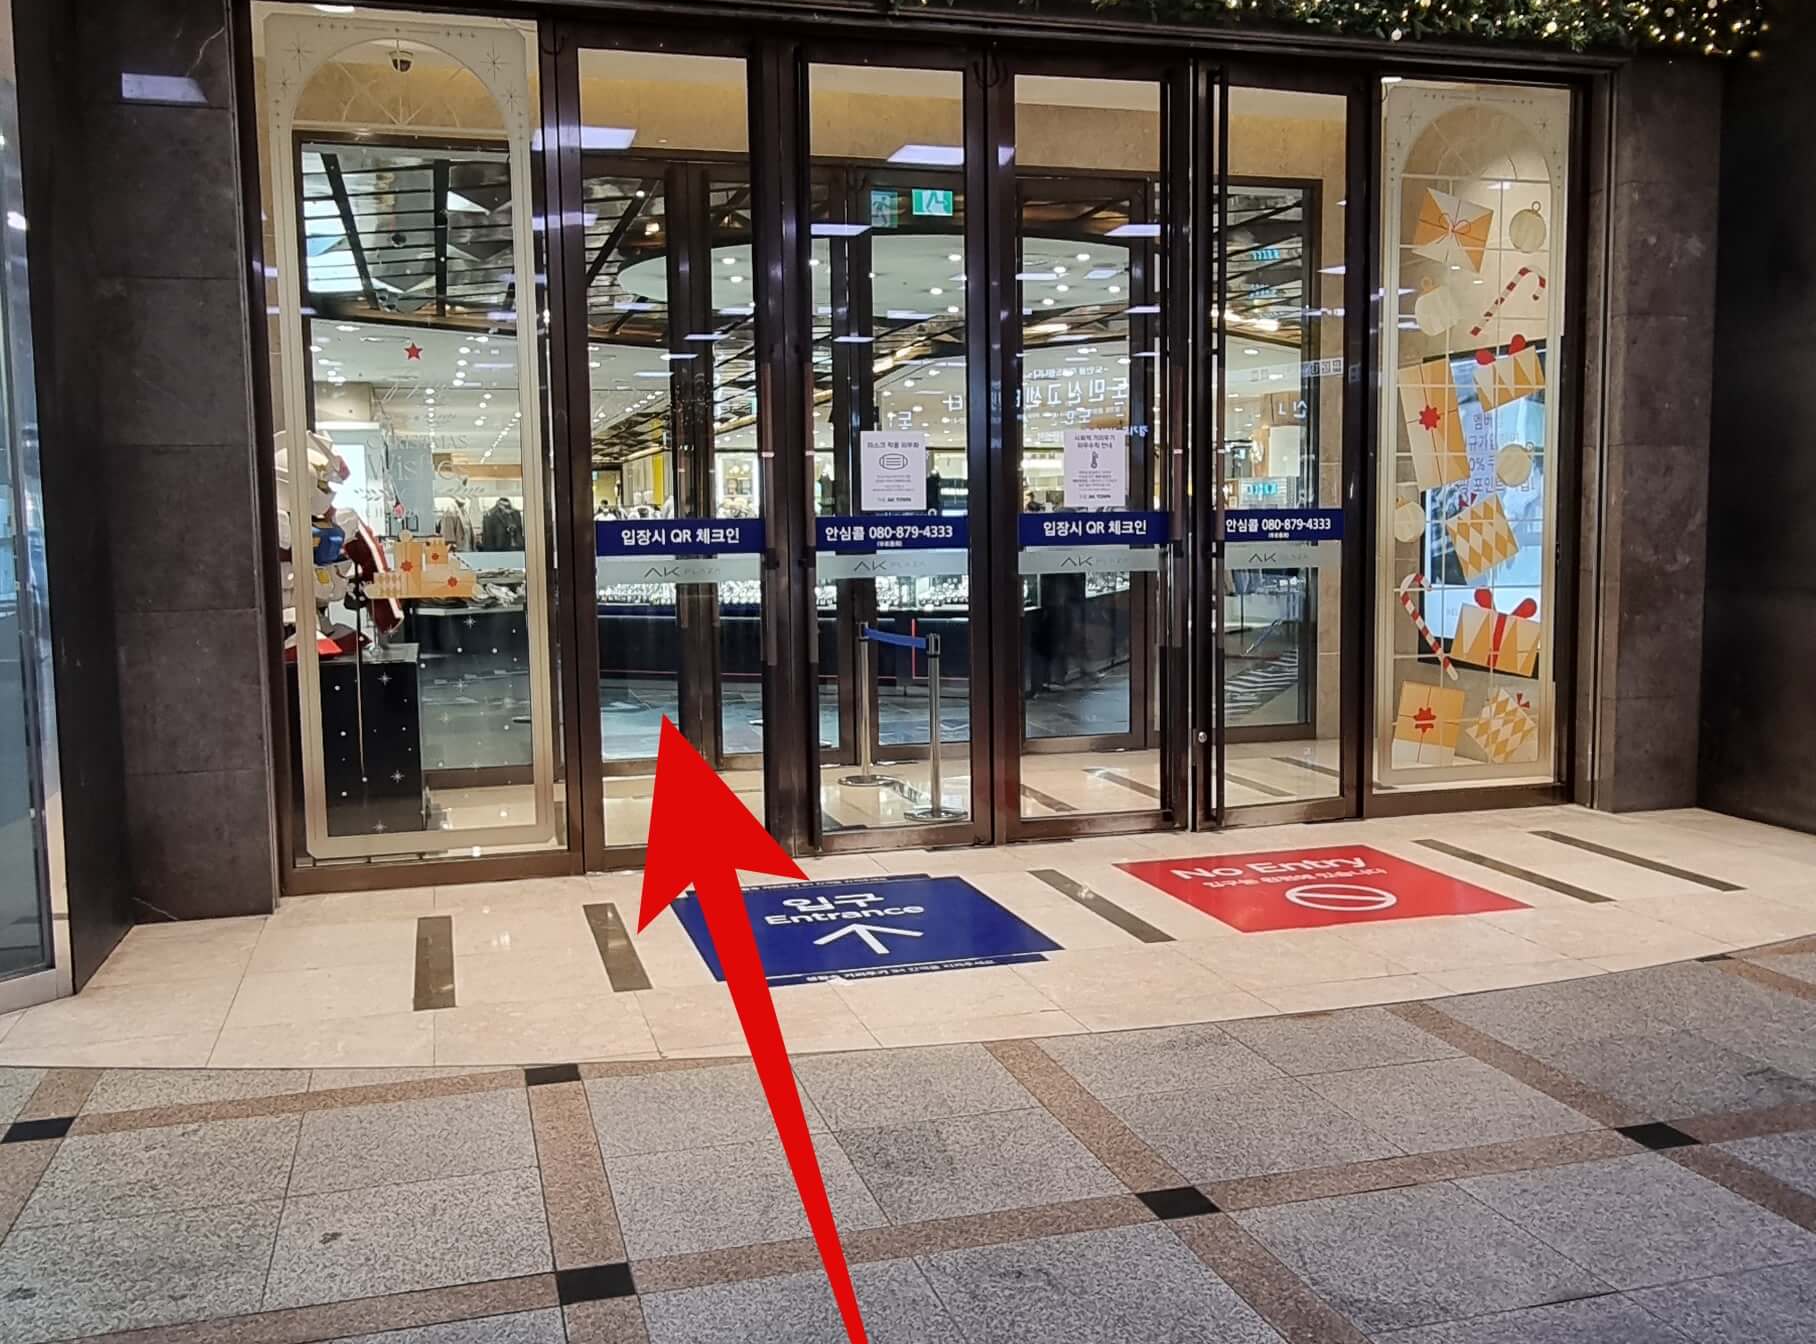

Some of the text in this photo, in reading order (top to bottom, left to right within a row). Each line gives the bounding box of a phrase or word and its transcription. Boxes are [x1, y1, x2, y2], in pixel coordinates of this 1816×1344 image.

[825, 525, 953, 542] 안심콜 080-879-4333
[1043, 519, 1147, 537] 입장시 QR 체크인
[1225, 517, 1331, 533] 안심콜 080-879-4333
[621, 527, 740, 546] 입장시 QR 체크인
[1170, 867, 1243, 880] No
[1245, 856, 1368, 874] Entry
[782, 892, 885, 913] 입구
[764, 905, 925, 925] Entrance
